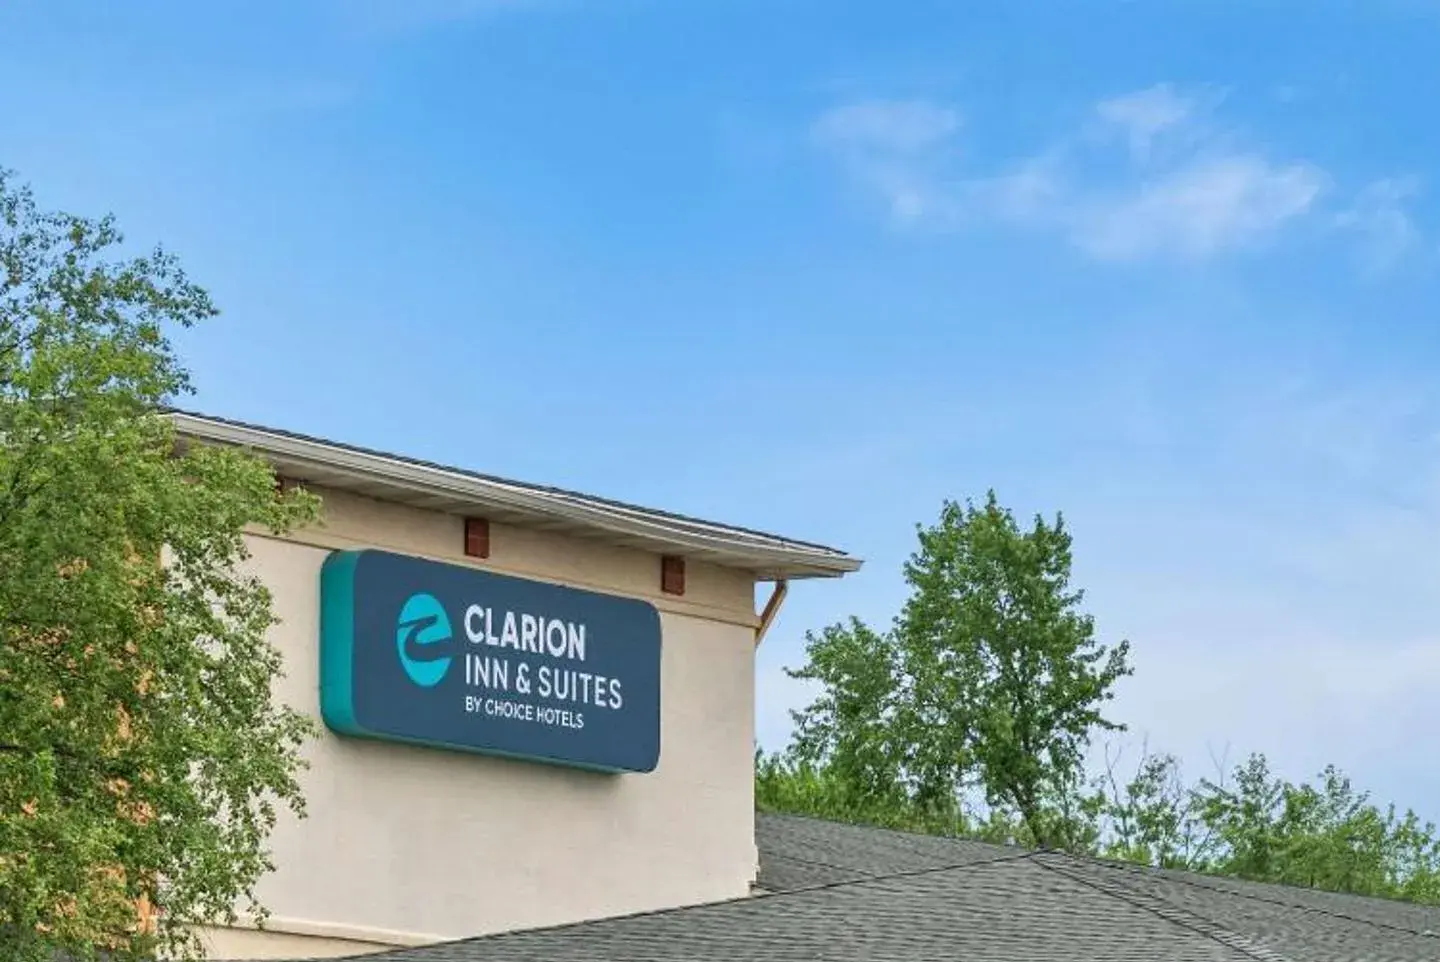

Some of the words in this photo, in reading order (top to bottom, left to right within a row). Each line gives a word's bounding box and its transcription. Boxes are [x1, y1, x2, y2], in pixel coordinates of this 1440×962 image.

[464, 604, 586, 661] CLARION
[465, 653, 508, 691] INN
[516, 662, 531, 694] &
[538, 665, 623, 709] SUITES
[465, 696, 483, 713] BY
[485, 699, 533, 721] CHOICE
[536, 706, 584, 729] HOTELS
